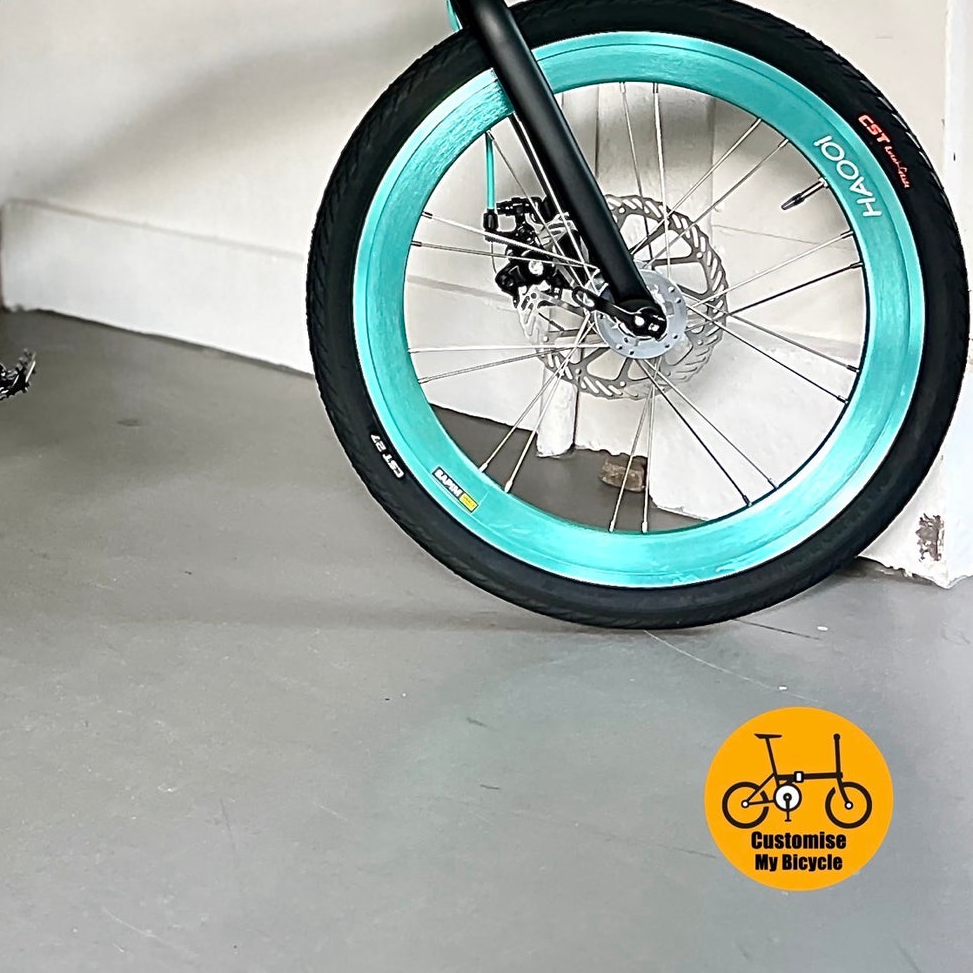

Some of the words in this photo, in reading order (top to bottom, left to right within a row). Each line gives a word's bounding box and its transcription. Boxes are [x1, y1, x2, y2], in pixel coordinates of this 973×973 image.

[858, 114, 891, 143] CST
[813, 135, 883, 217] HAOOI
[382, 453, 405, 479] CST
